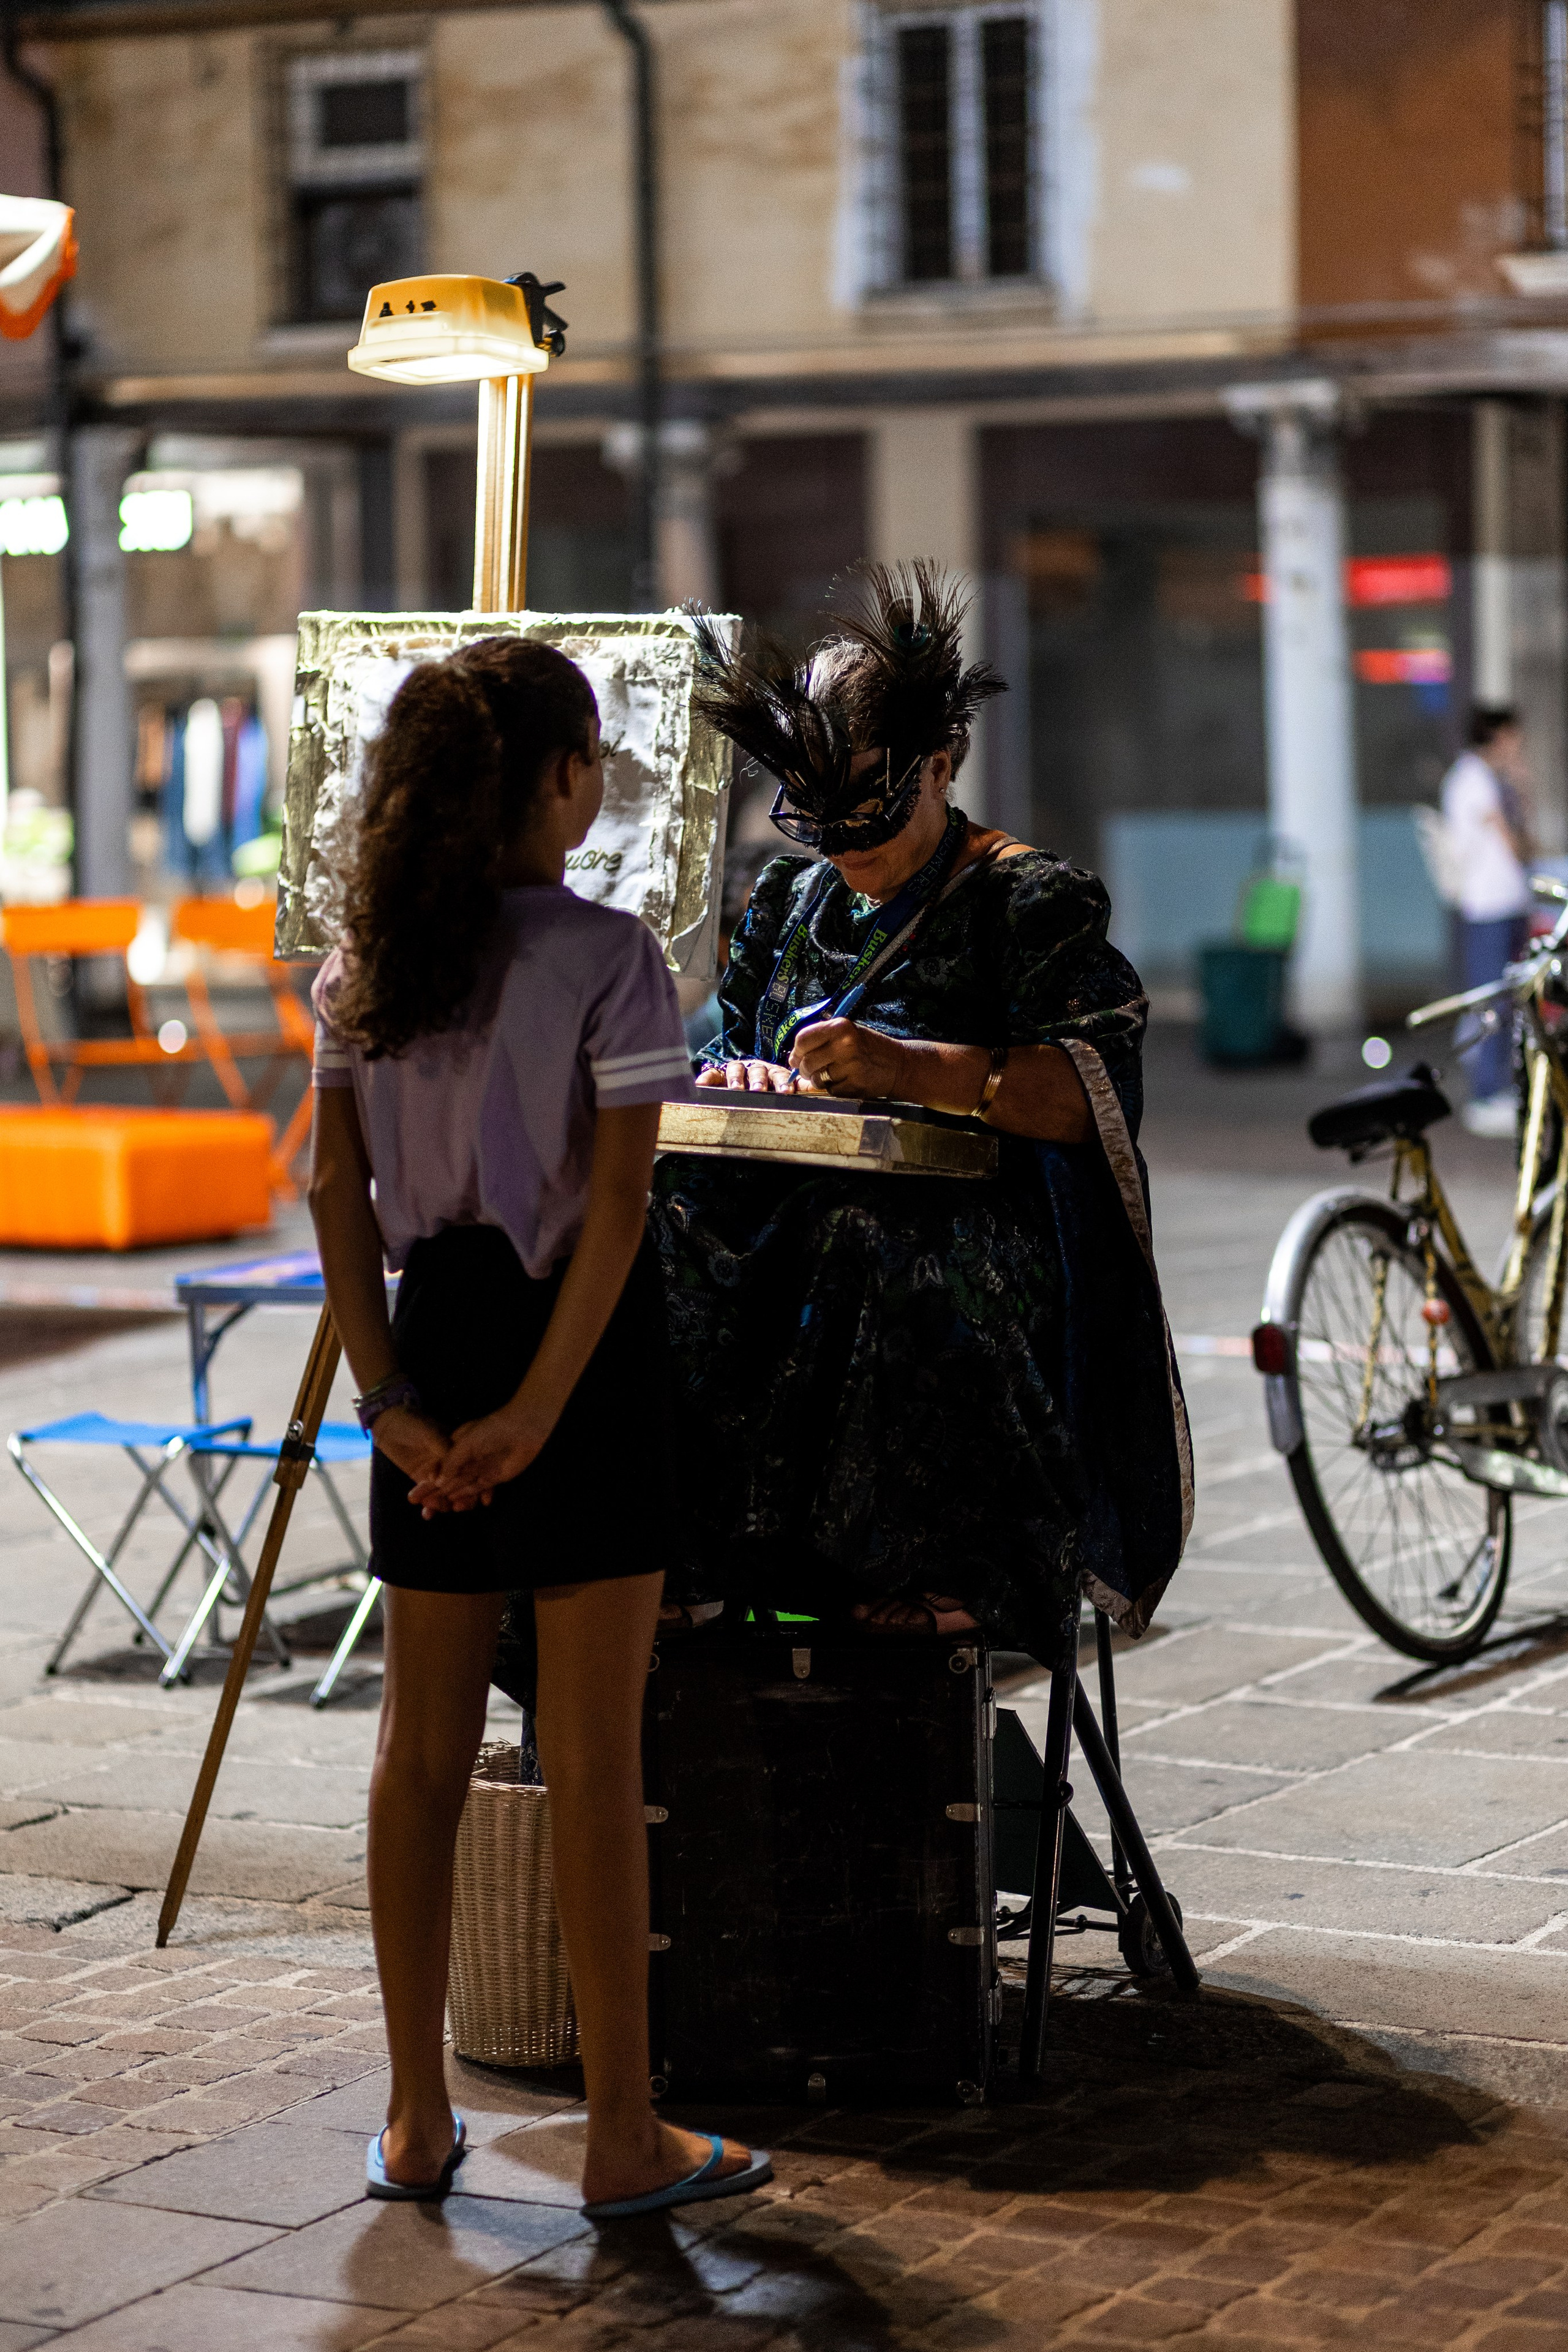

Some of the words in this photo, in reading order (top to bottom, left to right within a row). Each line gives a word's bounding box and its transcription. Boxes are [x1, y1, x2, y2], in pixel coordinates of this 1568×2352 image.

[565, 846, 623, 872] uore
[776, 924, 808, 984] Buskers
[841, 928, 889, 991] Buskers
[774, 1007, 813, 1057] uskers
